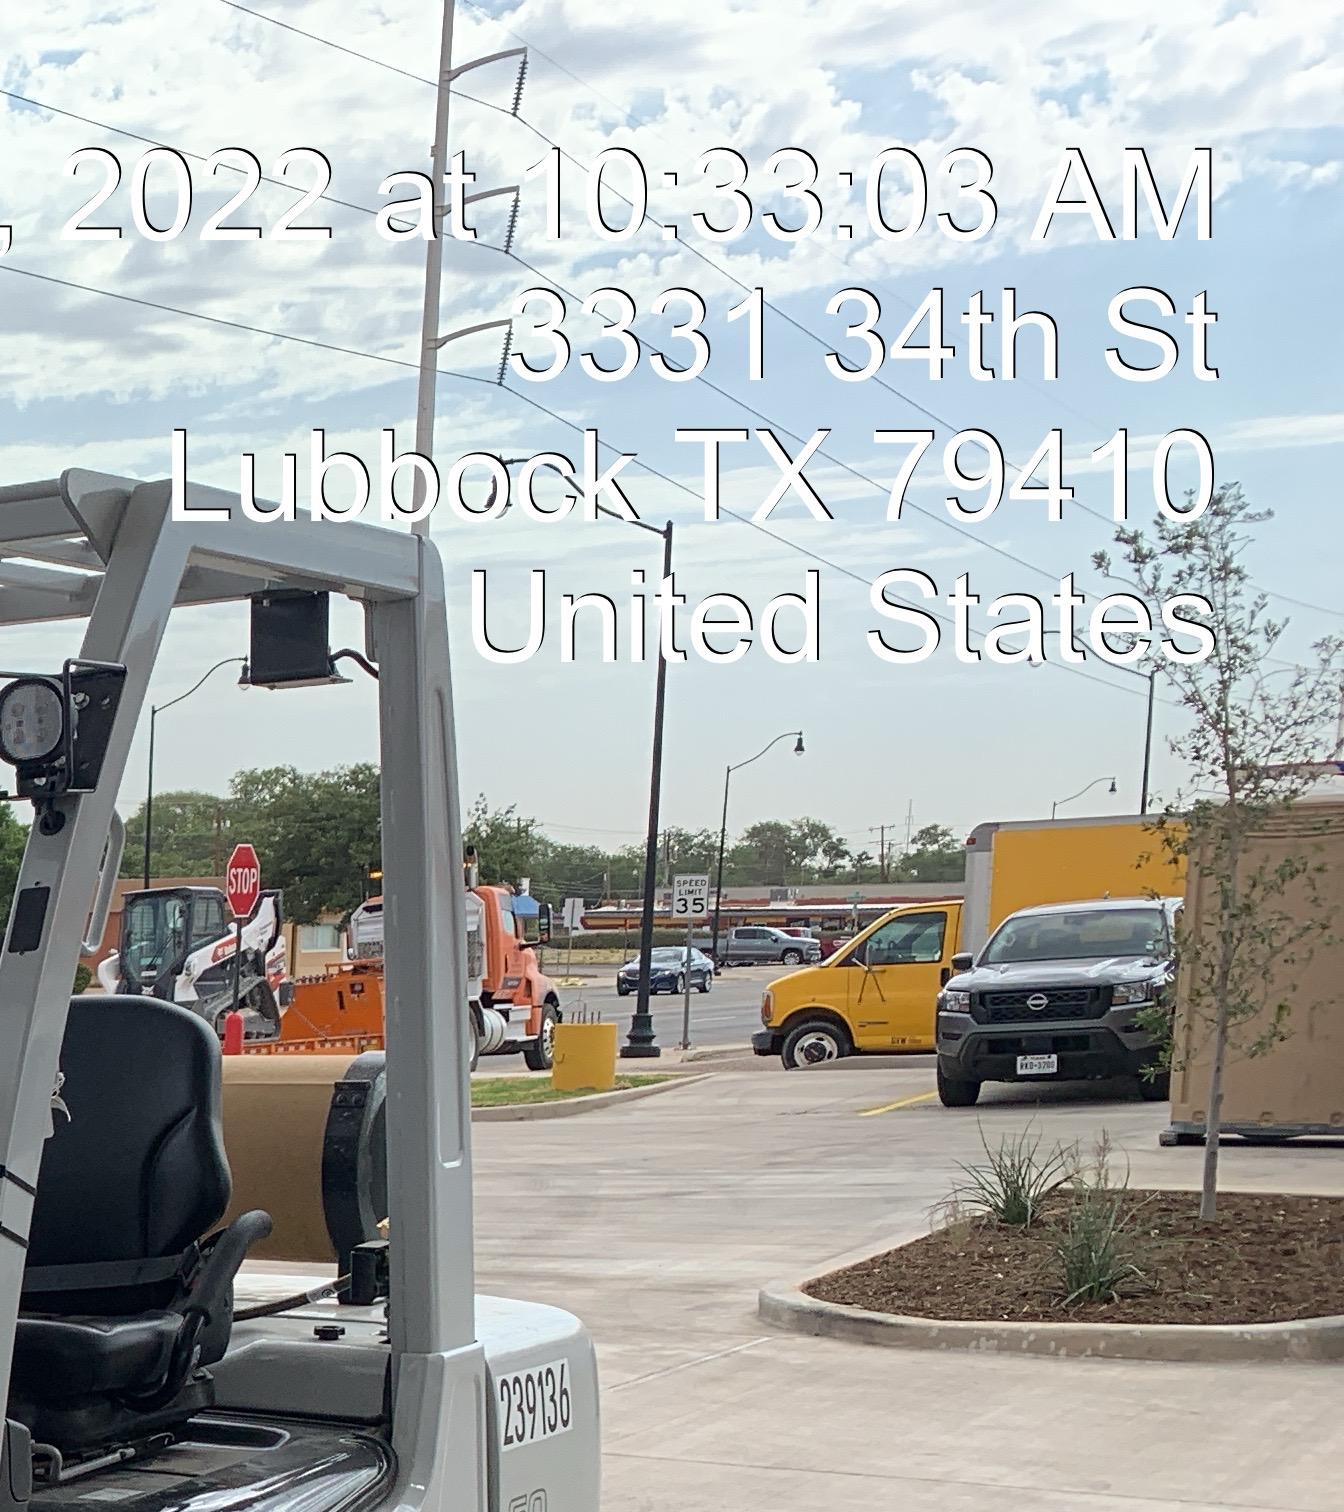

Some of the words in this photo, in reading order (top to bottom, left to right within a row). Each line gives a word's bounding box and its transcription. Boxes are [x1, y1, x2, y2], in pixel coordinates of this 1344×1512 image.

[228, 867, 258, 894] STOP
[676, 879, 707, 887] SPEED
[678, 888, 702, 896] LIMIT
[675, 897, 705, 914] 35
[499, 1363, 571, 1447] 239136
